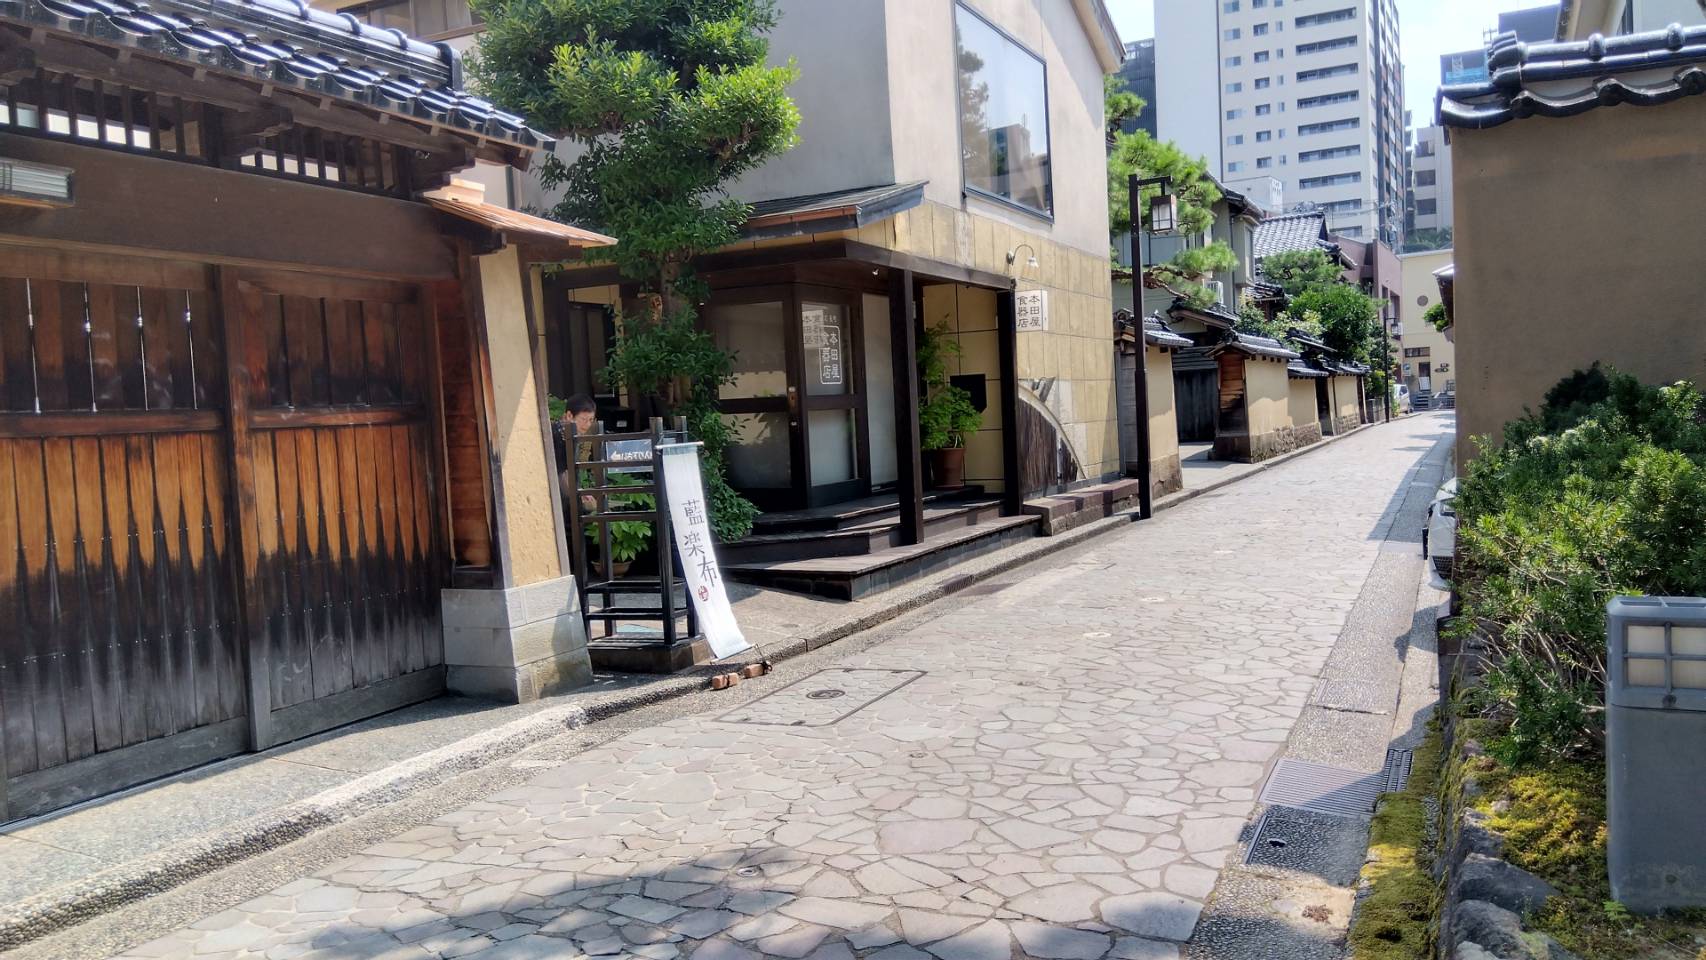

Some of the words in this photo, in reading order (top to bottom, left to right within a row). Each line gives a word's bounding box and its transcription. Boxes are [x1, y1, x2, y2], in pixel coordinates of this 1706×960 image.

[1016, 296, 1029, 328] 食器店
[1029, 295, 1040, 327] 本田屋
[829, 331, 840, 378] 本田屋
[682, 499, 717, 587] 藍楽布
